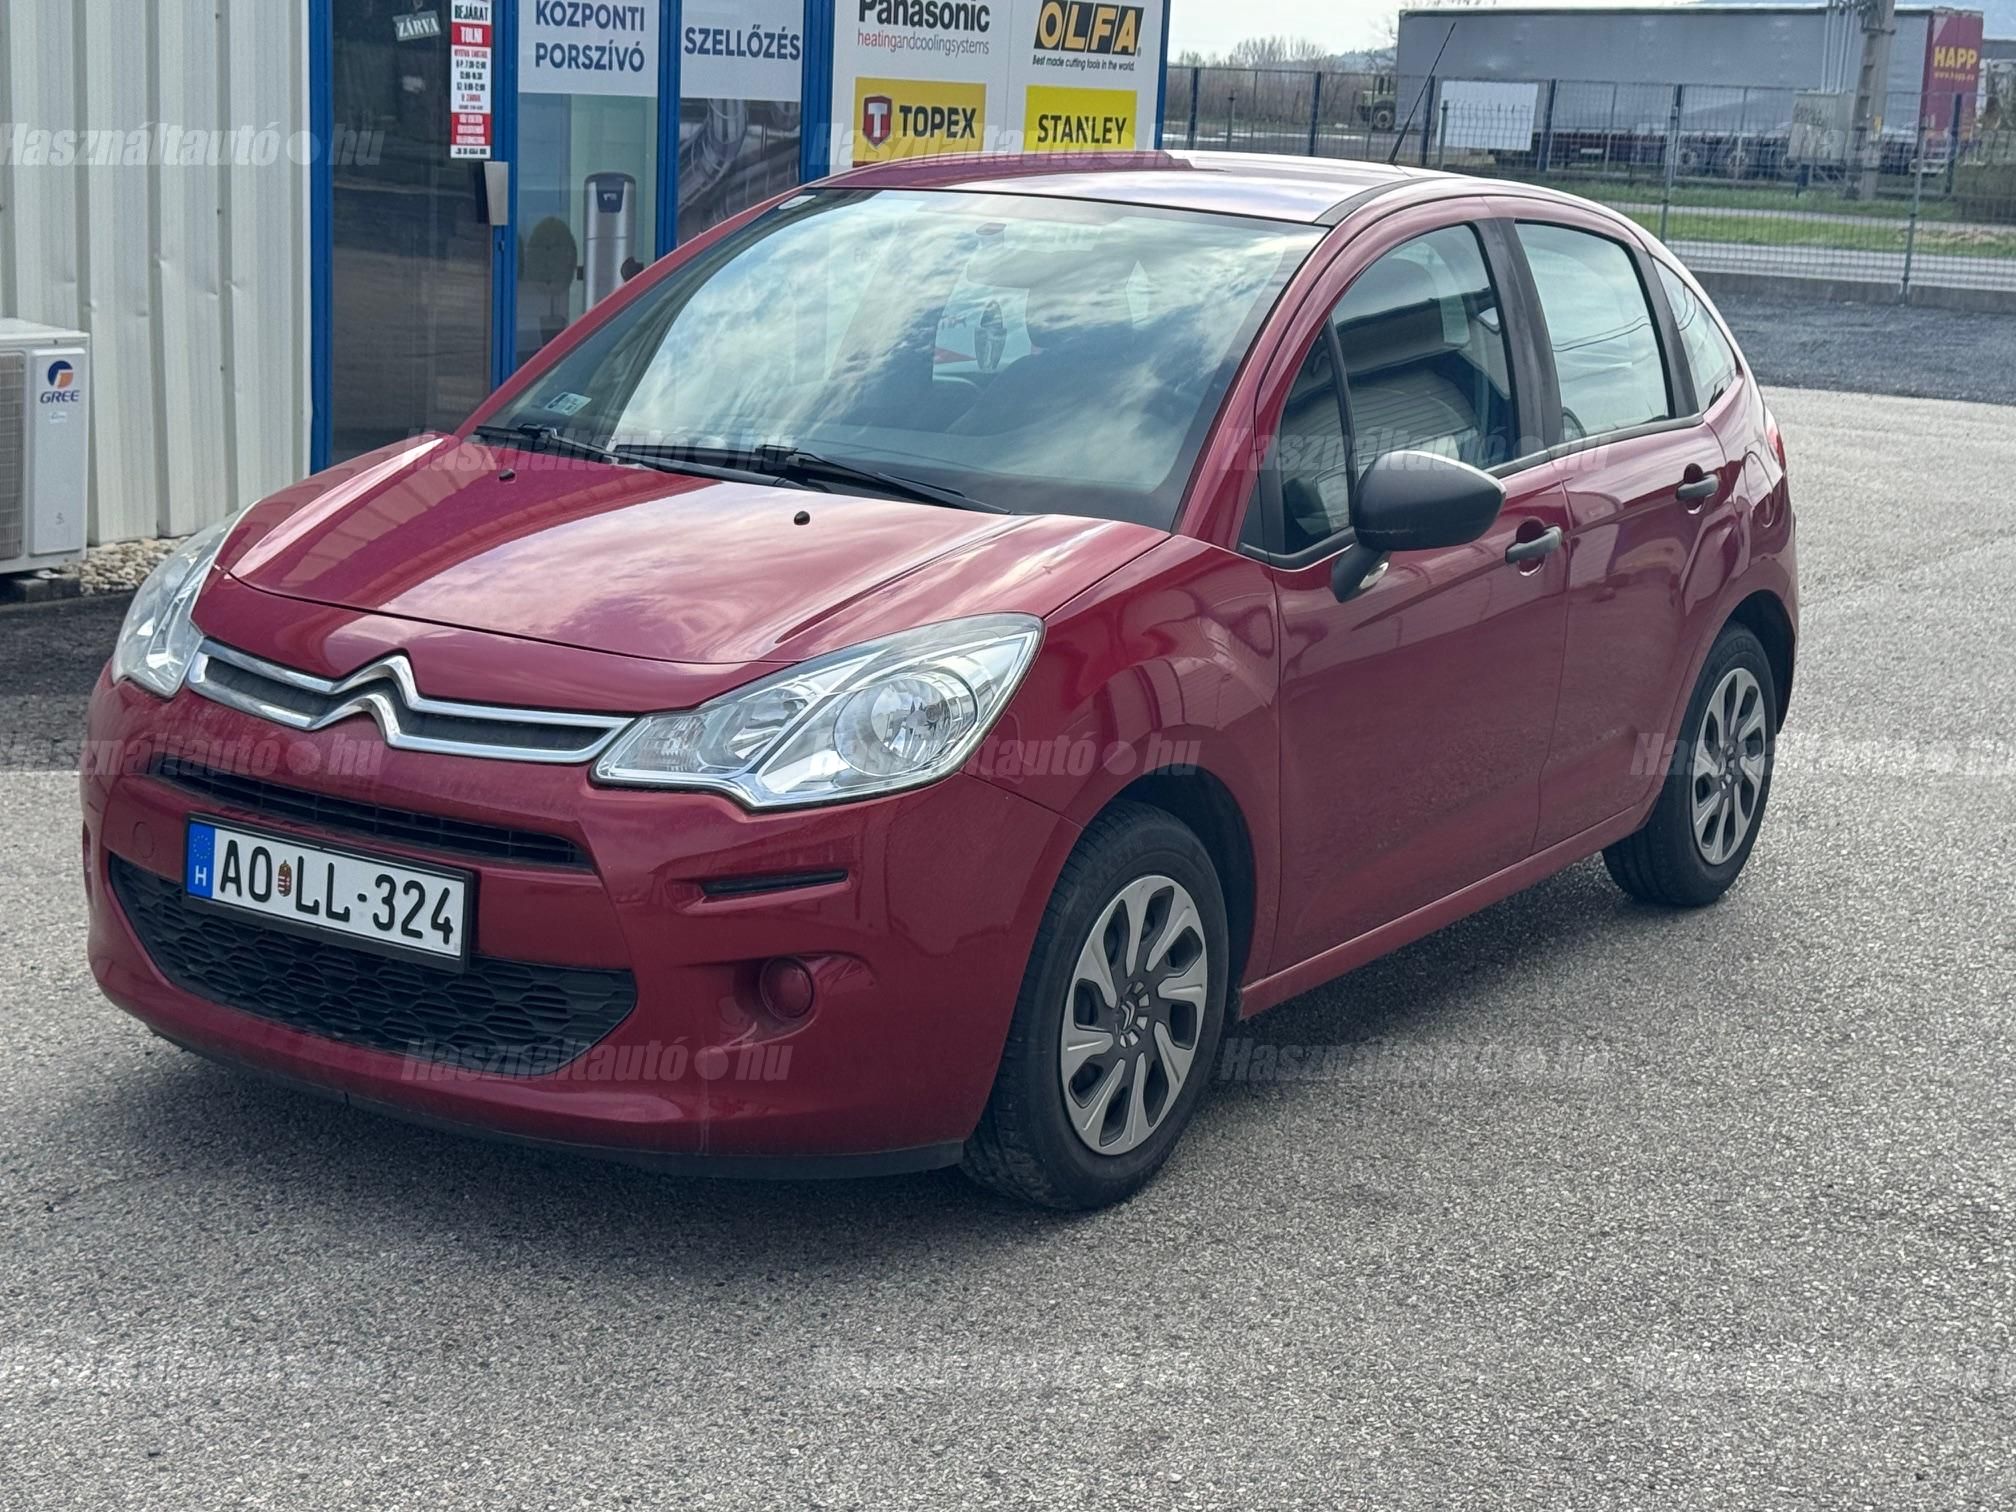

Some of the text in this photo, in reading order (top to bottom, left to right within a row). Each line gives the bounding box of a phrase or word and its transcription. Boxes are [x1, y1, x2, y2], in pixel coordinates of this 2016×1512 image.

[396, 17, 440, 38] ZÁRVA
[858, 0, 991, 33] Panasonic
[1038, 1, 1137, 54] OLFA
[535, 39, 645, 73] PORSZÍVÓ
[684, 24, 801, 61] SZELLŐZÉS
[857, 28, 990, 58] heatingandcoolingsystems
[1934, 46, 1977, 70] HAPP
[899, 105, 977, 139] TOPEX
[1037, 113, 1127, 145] STANLEY
[40, 390, 80, 404] GREE
[194, 864, 207, 887] H
[219, 838, 455, 945] AO LL-324
